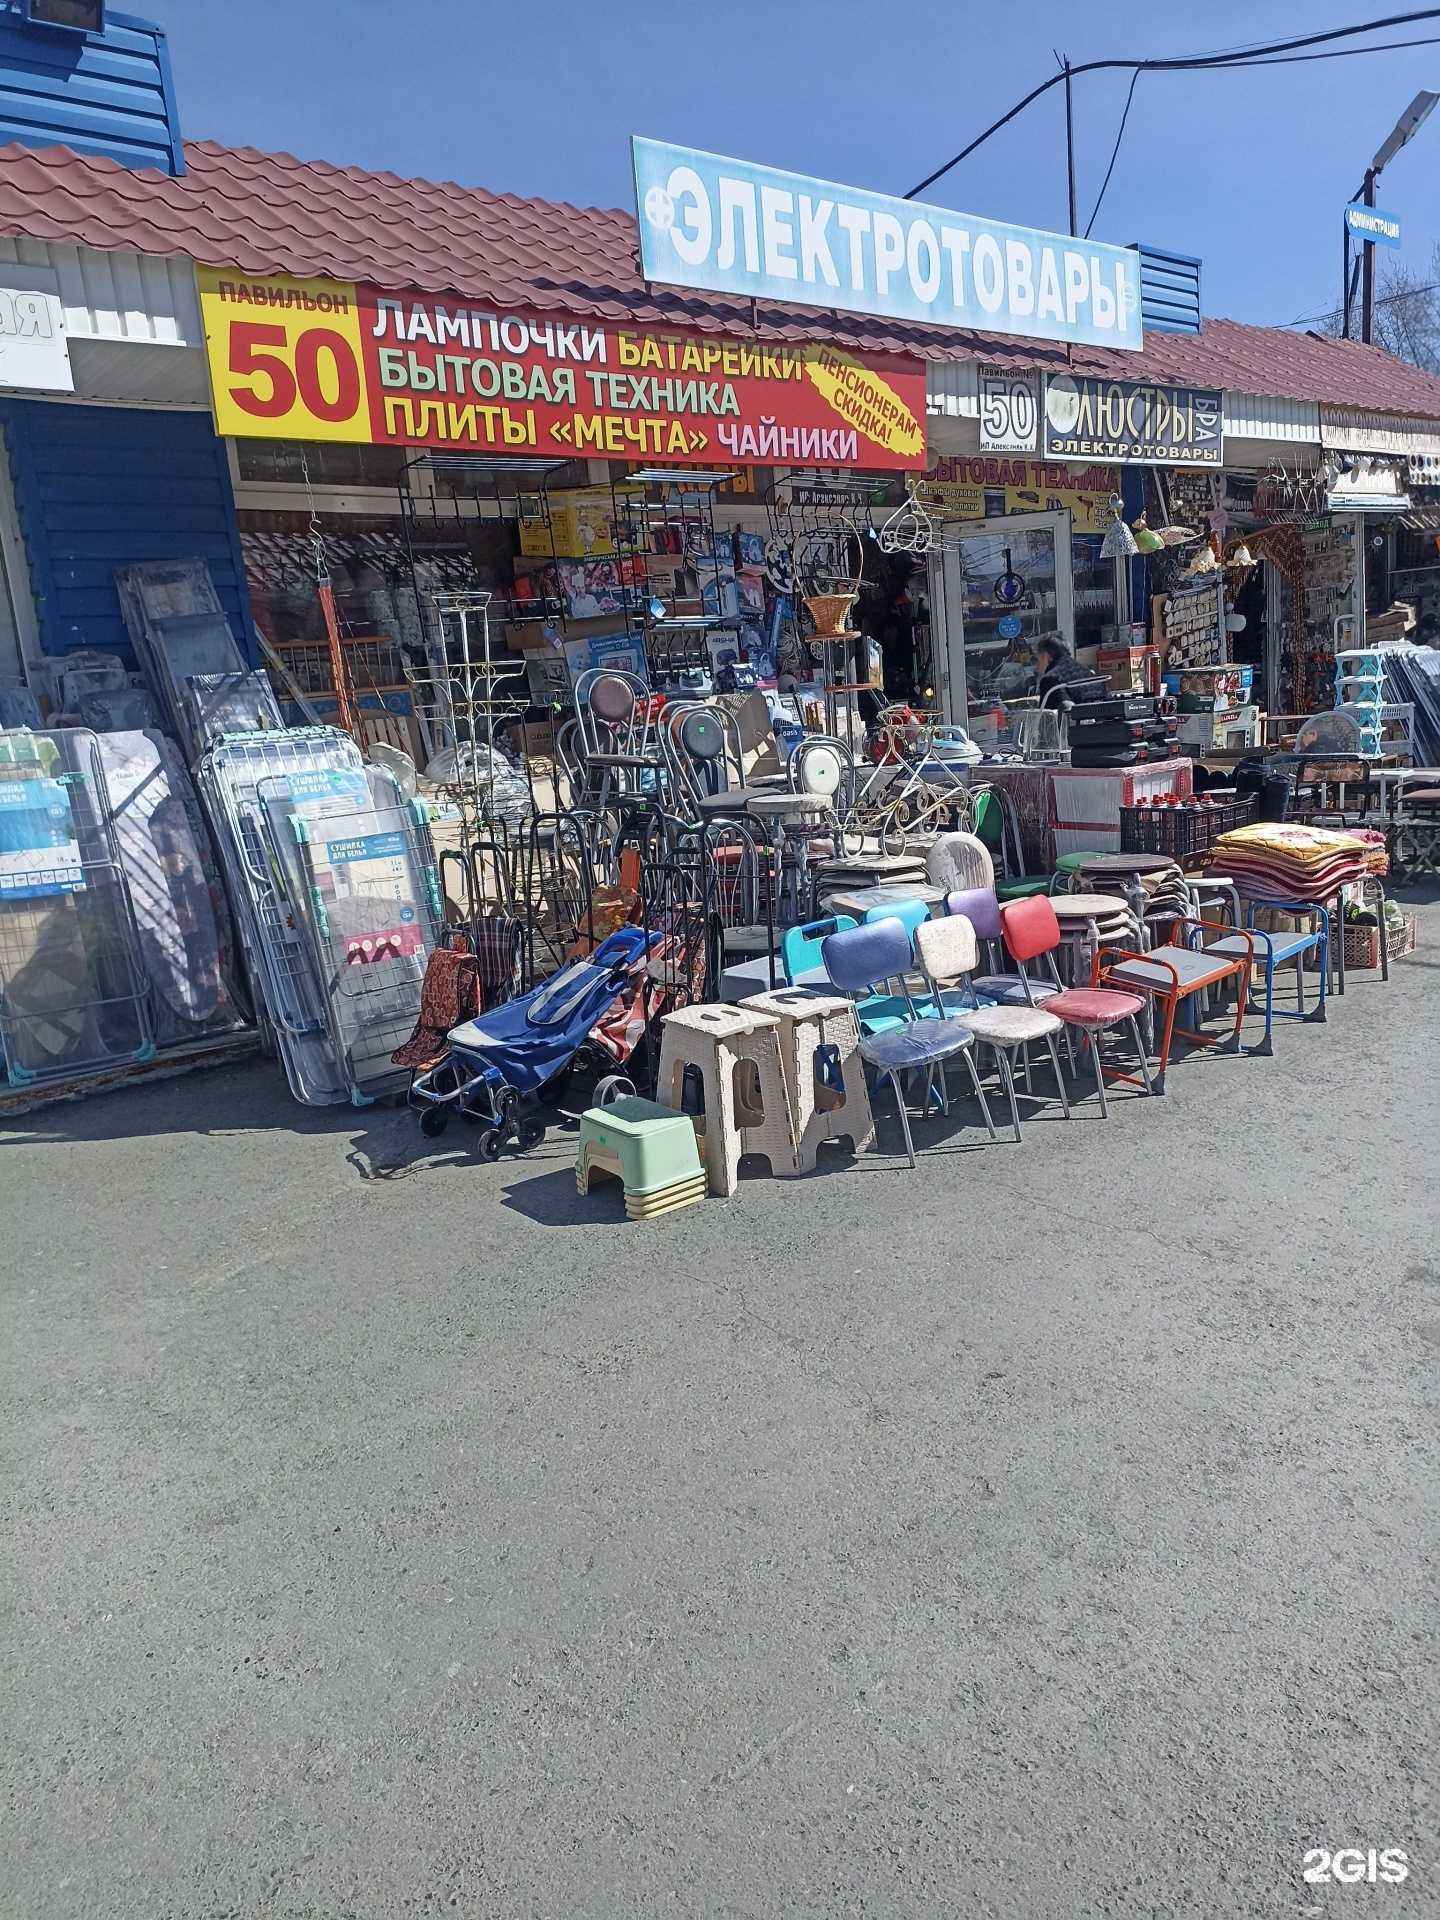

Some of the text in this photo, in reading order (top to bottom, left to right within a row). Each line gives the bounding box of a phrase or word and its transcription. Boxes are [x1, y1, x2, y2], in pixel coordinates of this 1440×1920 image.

[665, 165, 1126, 332] ЭЛЕКТРОТОВАРЫ
[1349, 208, 1399, 239] АДМИНИСТРАЦИЯ
[218, 280, 349, 315] ПАВИЛЬОН
[372, 297, 803, 381] ЛАМПОЧКИ БАТАРЕЙКИ
[228, 320, 359, 422] 50
[378, 347, 741, 416] БЫТОВАЯ ТЕХНИКА
[818, 349, 918, 440] ПЕНСИОНЕРАМ
[383, 396, 858, 460] ПЛИТЫ «МЕЧТА» ЧАЙНИКИ
[833, 387, 893, 444] СКИДКА!
[983, 379, 1034, 440] 50
[1076, 381, 1193, 443] ЛЮСТРЫ
[1195, 398, 1218, 442] БРА
[1051, 438, 1217, 460] ЭЛЕКТРОТОВАРЫ
